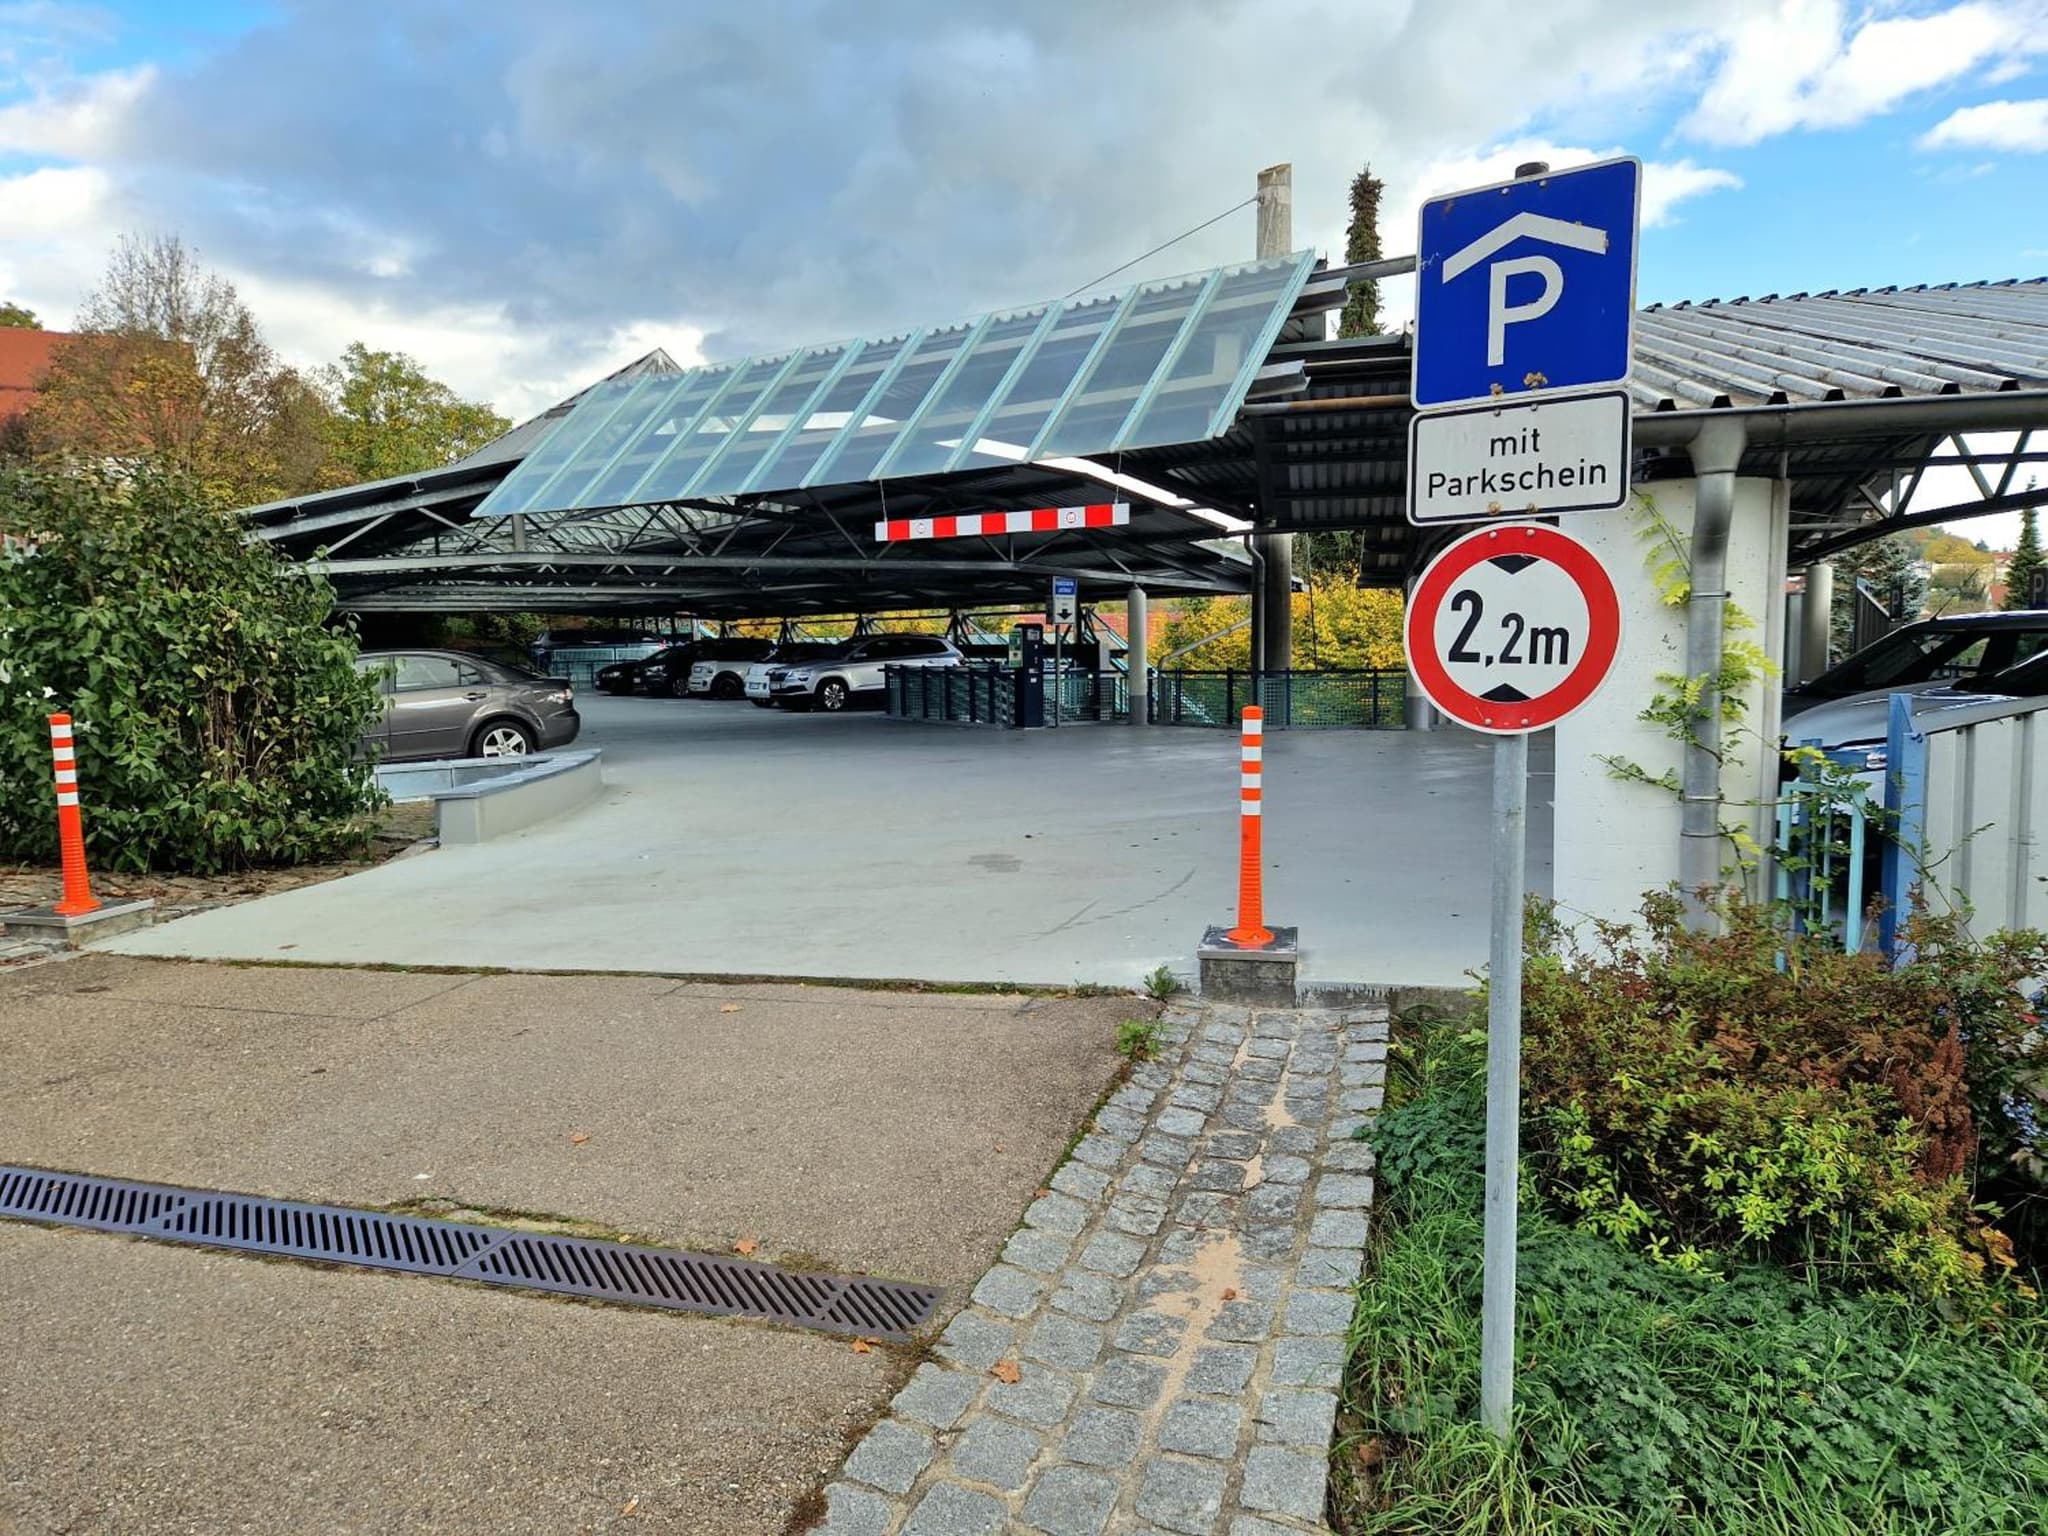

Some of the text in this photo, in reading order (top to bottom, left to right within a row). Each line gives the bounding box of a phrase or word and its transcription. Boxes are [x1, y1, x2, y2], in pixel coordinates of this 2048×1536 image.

[1488, 255, 1564, 367] P
[1490, 428, 1540, 457] mit
[1428, 459, 1606, 499] Parkschein
[1448, 589, 1570, 668] 2,2m
